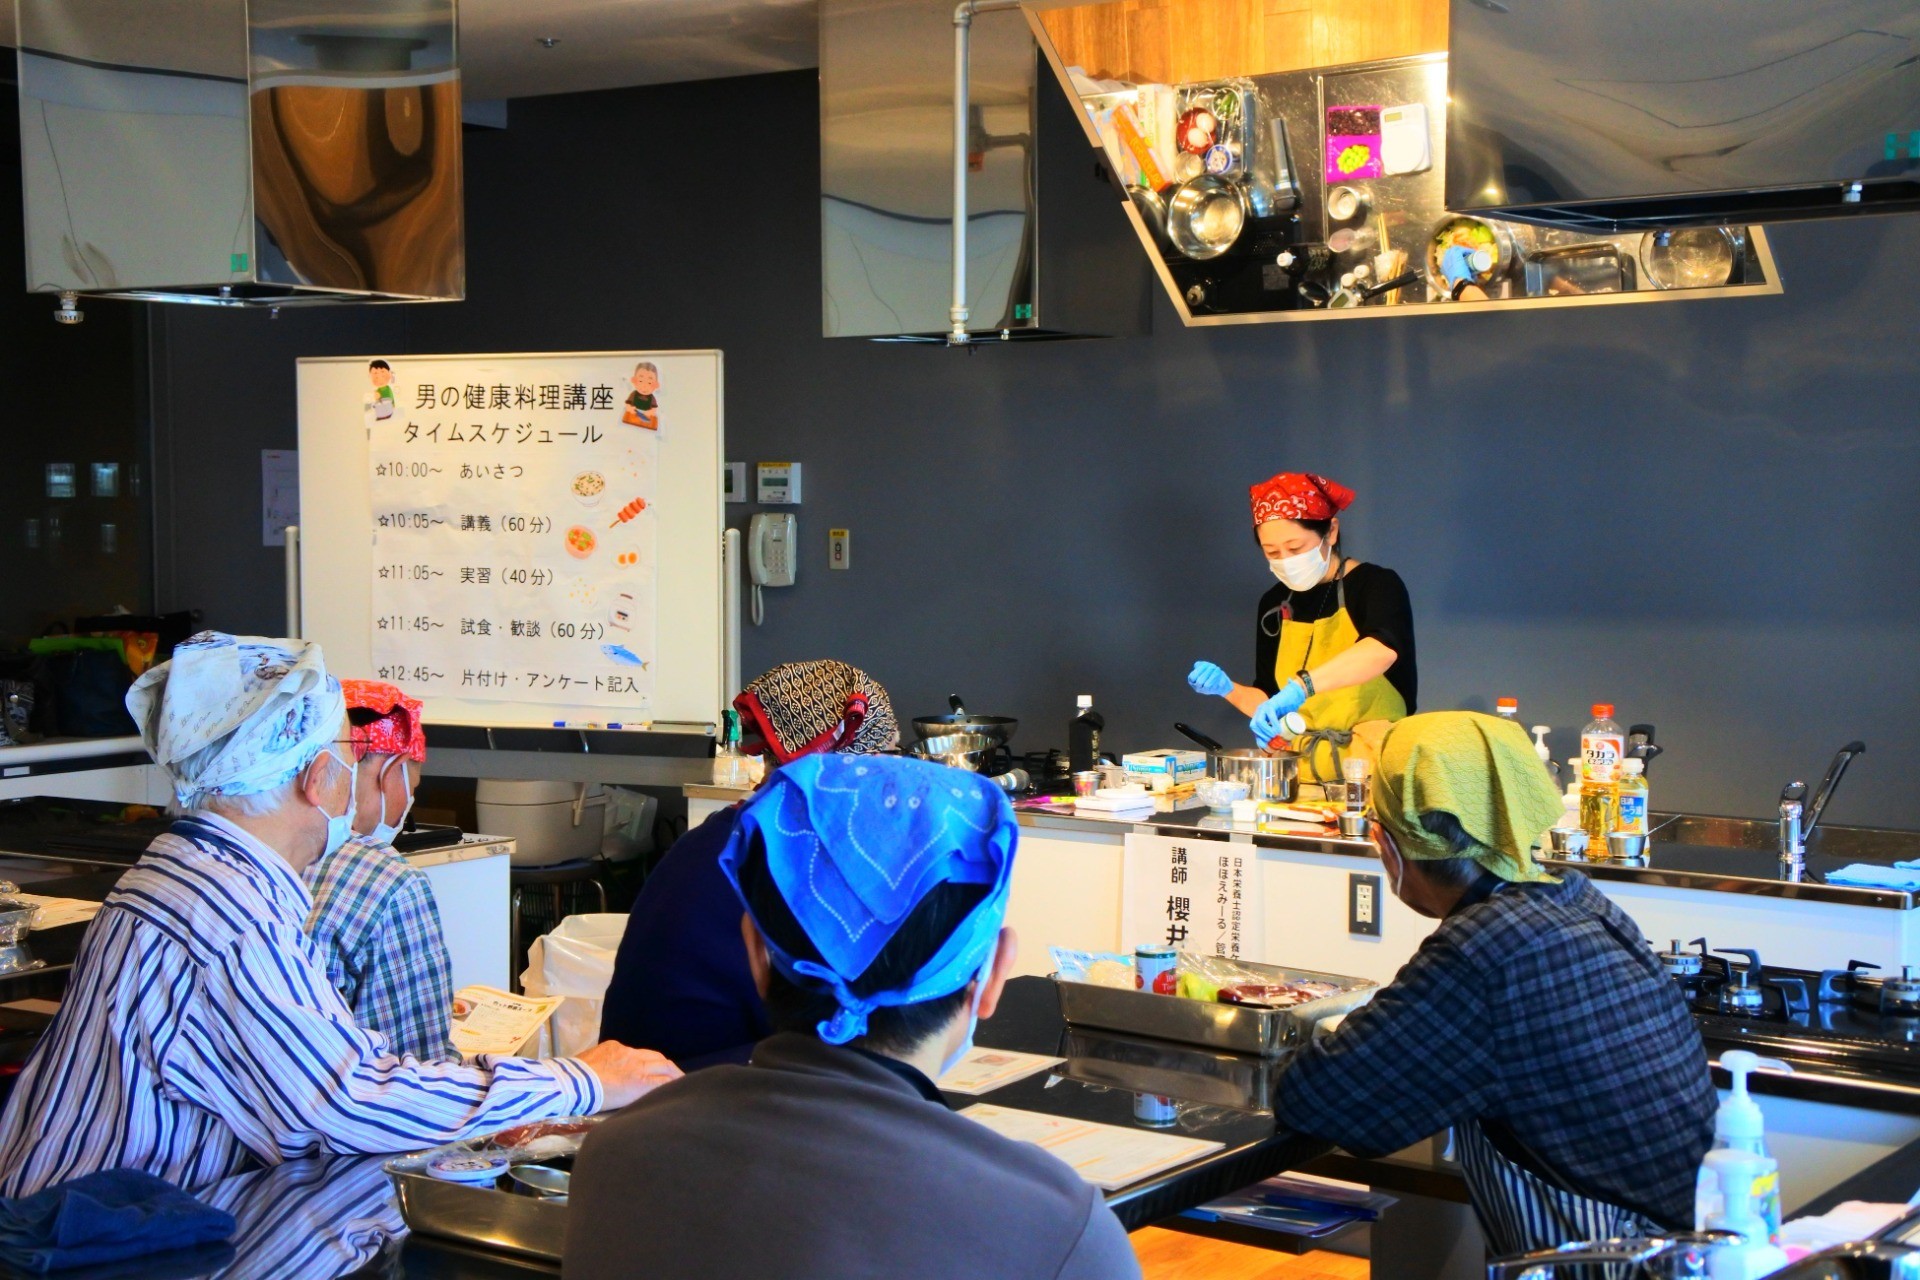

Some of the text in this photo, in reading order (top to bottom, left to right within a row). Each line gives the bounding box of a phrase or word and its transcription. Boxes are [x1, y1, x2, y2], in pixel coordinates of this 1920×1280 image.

[415, 383, 614, 411] 男の健康料理講座
[403, 421, 604, 444] タイムスケジュール
[459, 462, 523, 480] あいさつ
[1171, 846, 1187, 884] 講師
